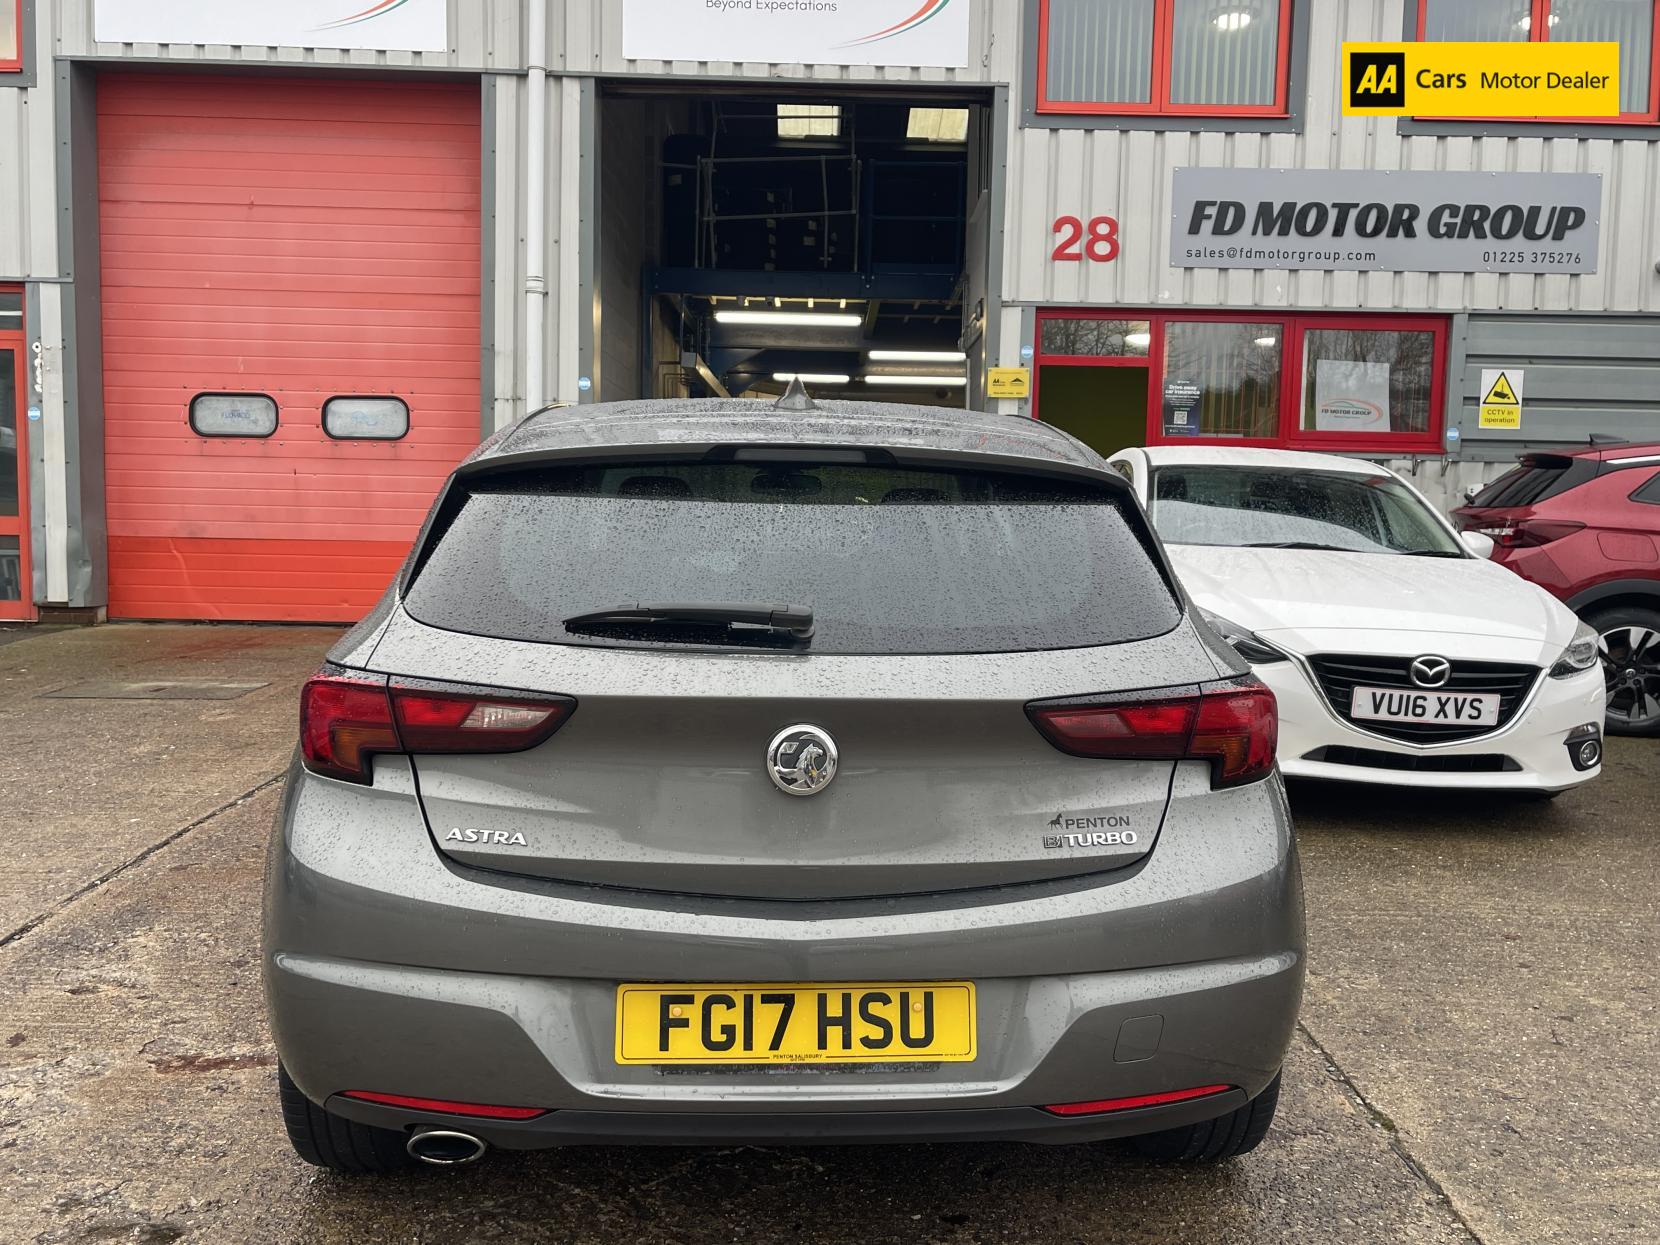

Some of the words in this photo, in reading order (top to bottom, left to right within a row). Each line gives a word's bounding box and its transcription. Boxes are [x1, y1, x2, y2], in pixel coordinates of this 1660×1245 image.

[706, 0, 752, 12] Beyond
[756, 0, 837, 13] Expectations
[1187, 200, 1246, 236] FD
[1251, 201, 1420, 239] MOTOR
[1427, 204, 1586, 241] GROUP
[1051, 215, 1120, 263] 28
[1186, 246, 1376, 263] sales@fdmotorgroup.com
[1482, 252, 1526, 264] 01225
[1531, 252, 1582, 265] 375276
[1371, 691, 1427, 717] VU16
[1434, 695, 1484, 720] XVS
[1065, 816, 1130, 829] PENTON
[445, 827, 528, 846] ASTRA
[659, 993, 796, 1051] FG17
[817, 991, 934, 1049] HSU
